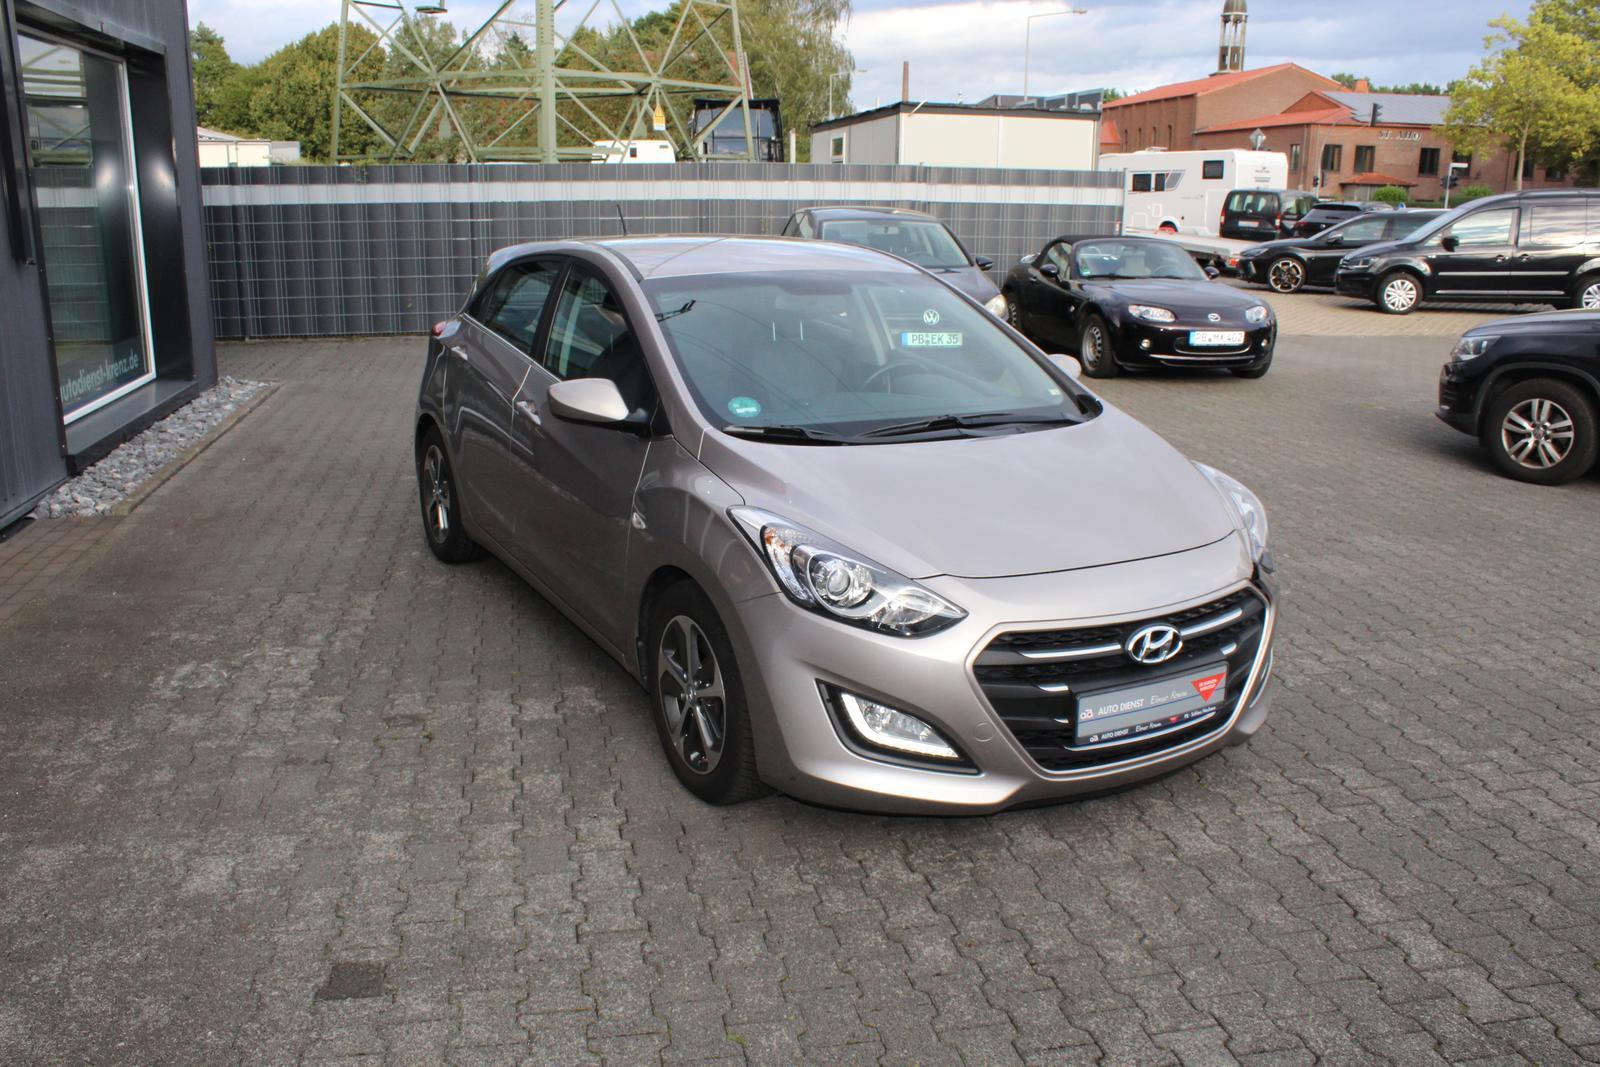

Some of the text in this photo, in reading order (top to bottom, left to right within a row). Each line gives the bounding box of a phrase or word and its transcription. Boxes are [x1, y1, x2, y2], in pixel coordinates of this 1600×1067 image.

[911, 334, 924, 344] PB
[931, 334, 944, 344] EK
[1097, 704, 1119, 716] AUTO
[1119, 698, 1144, 712] DIENST
